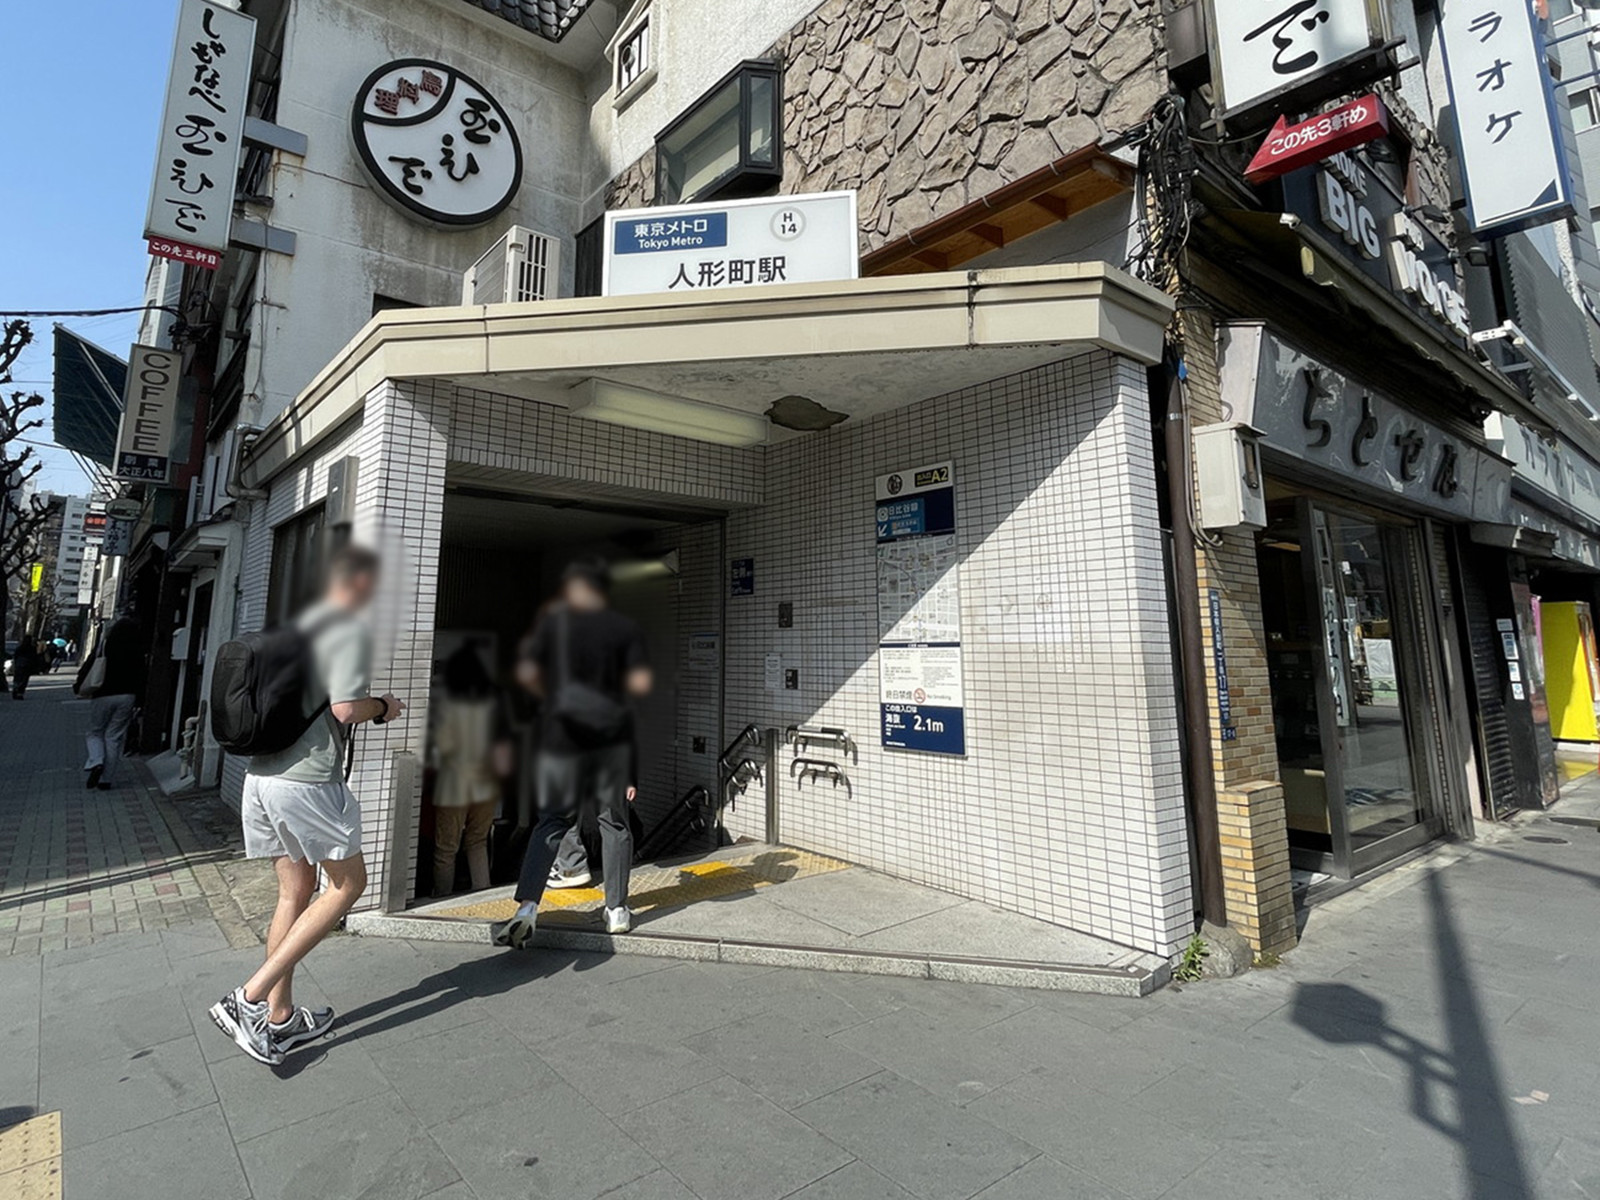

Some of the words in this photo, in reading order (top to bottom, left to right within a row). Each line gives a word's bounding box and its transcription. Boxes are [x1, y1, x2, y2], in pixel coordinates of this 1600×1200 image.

[1271, 105, 1367, 155] この先3軒め
[783, 213, 792, 222] H
[1325, 171, 1380, 258] BIG
[634, 219, 708, 238] 東京メトロ
[780, 223, 797, 235] 14
[638, 238, 669, 249] Tokyo
[671, 236, 703, 247] Metro
[668, 256, 786, 289] 人形町駅
[132, 353, 172, 453] COFFEE
[119, 466, 164, 478] 大正八年
[931, 467, 948, 483] A2
[913, 715, 944, 733] 2.1m
